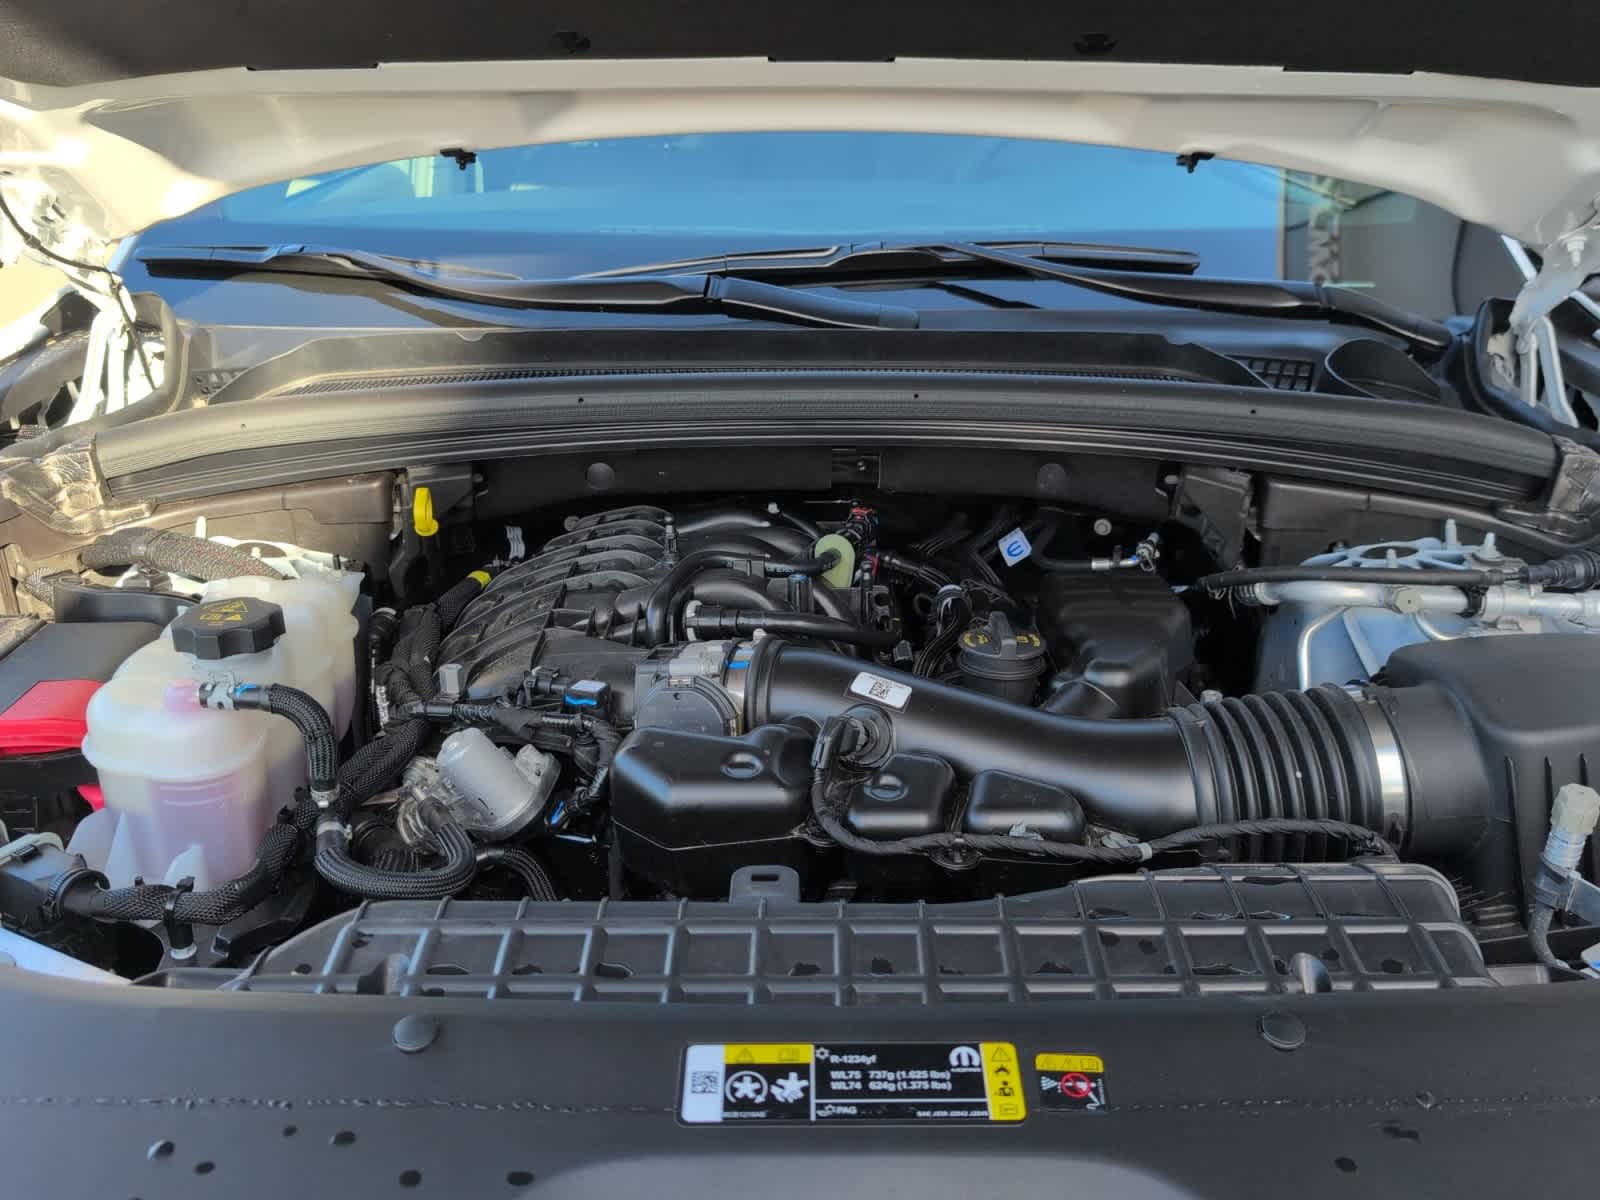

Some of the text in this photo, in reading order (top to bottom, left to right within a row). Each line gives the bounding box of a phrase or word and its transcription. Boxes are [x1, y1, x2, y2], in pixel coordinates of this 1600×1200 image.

[830, 1055, 877, 1065] R-1234yf
[830, 1070, 862, 1080] WL75
[868, 1070, 896, 1081] 737g
[896, 1070, 929, 1081] (1.625
[930, 1070, 951, 1081] lbs)
[830, 1081, 953, 1092] WL74 624g (1.375 lbs)
[836, 1105, 858, 1115] PAG
